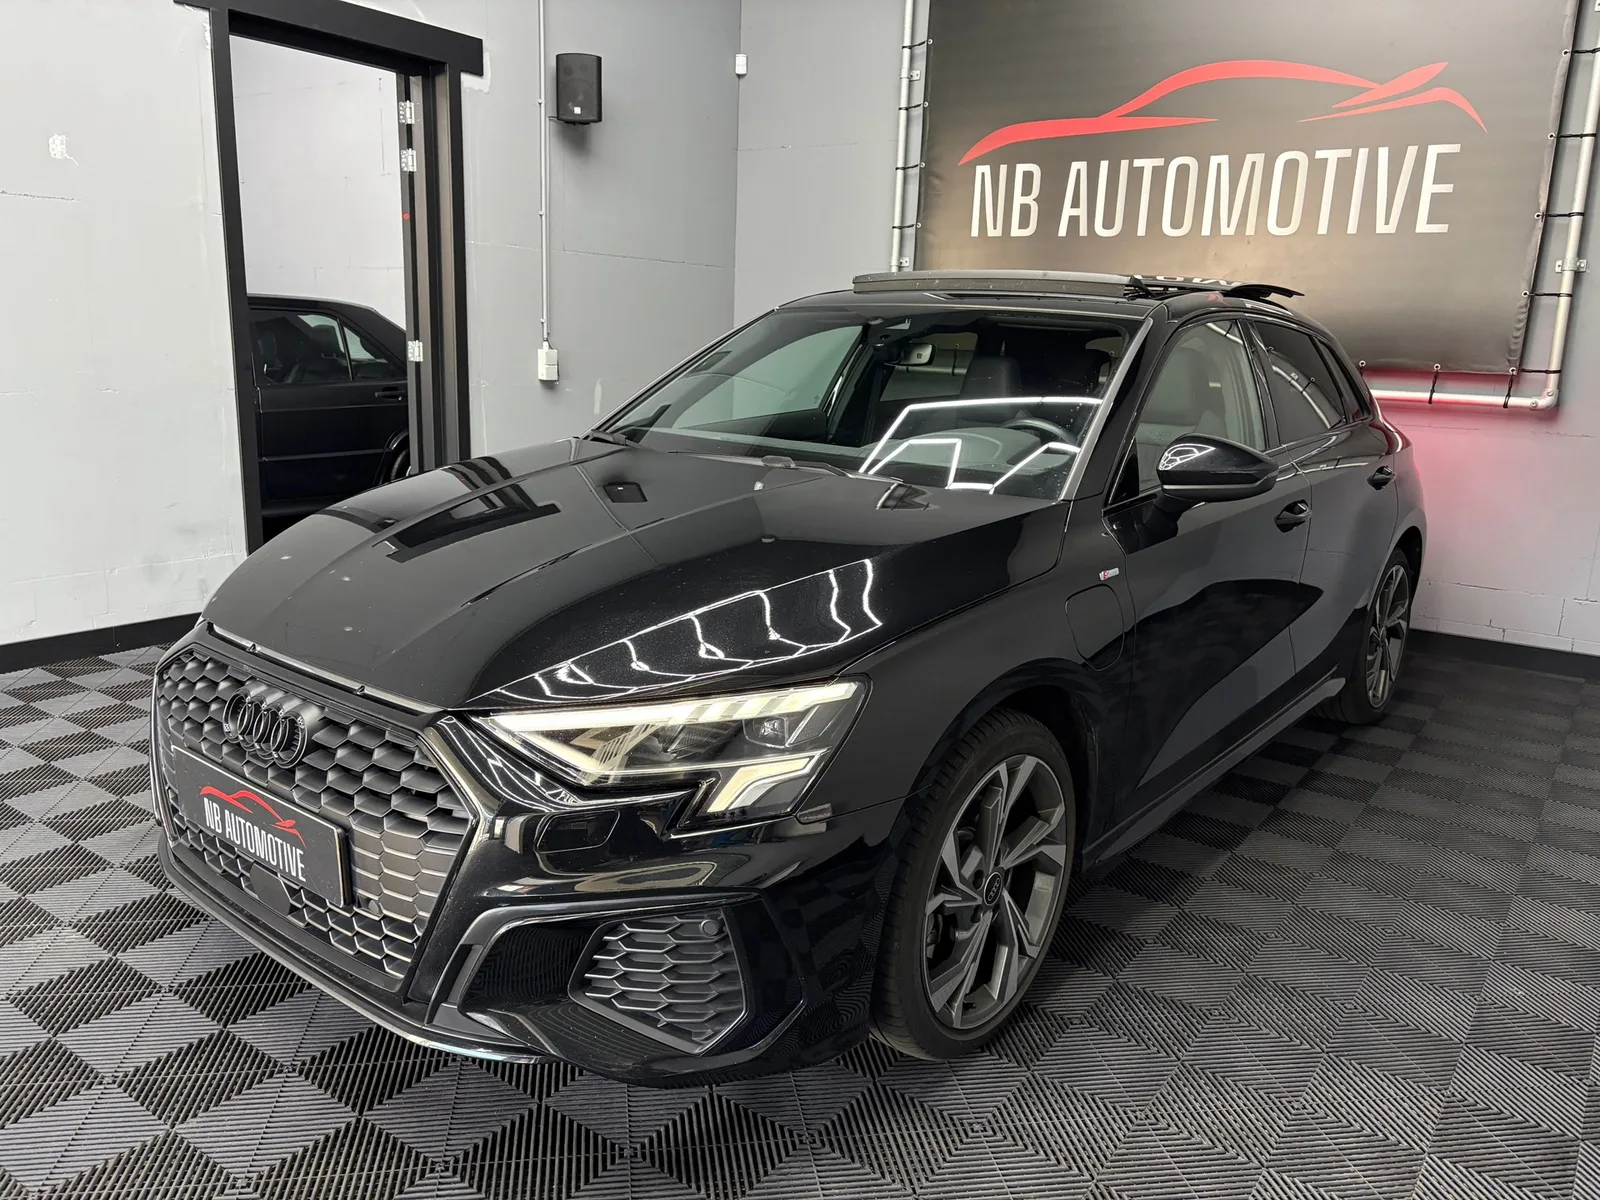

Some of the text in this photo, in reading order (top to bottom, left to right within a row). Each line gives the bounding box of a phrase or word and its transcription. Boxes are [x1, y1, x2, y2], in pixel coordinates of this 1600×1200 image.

[970, 144, 1461, 237] NB AUTOMOTIVE
[203, 797, 307, 882] NB AUTOMOTIVE
